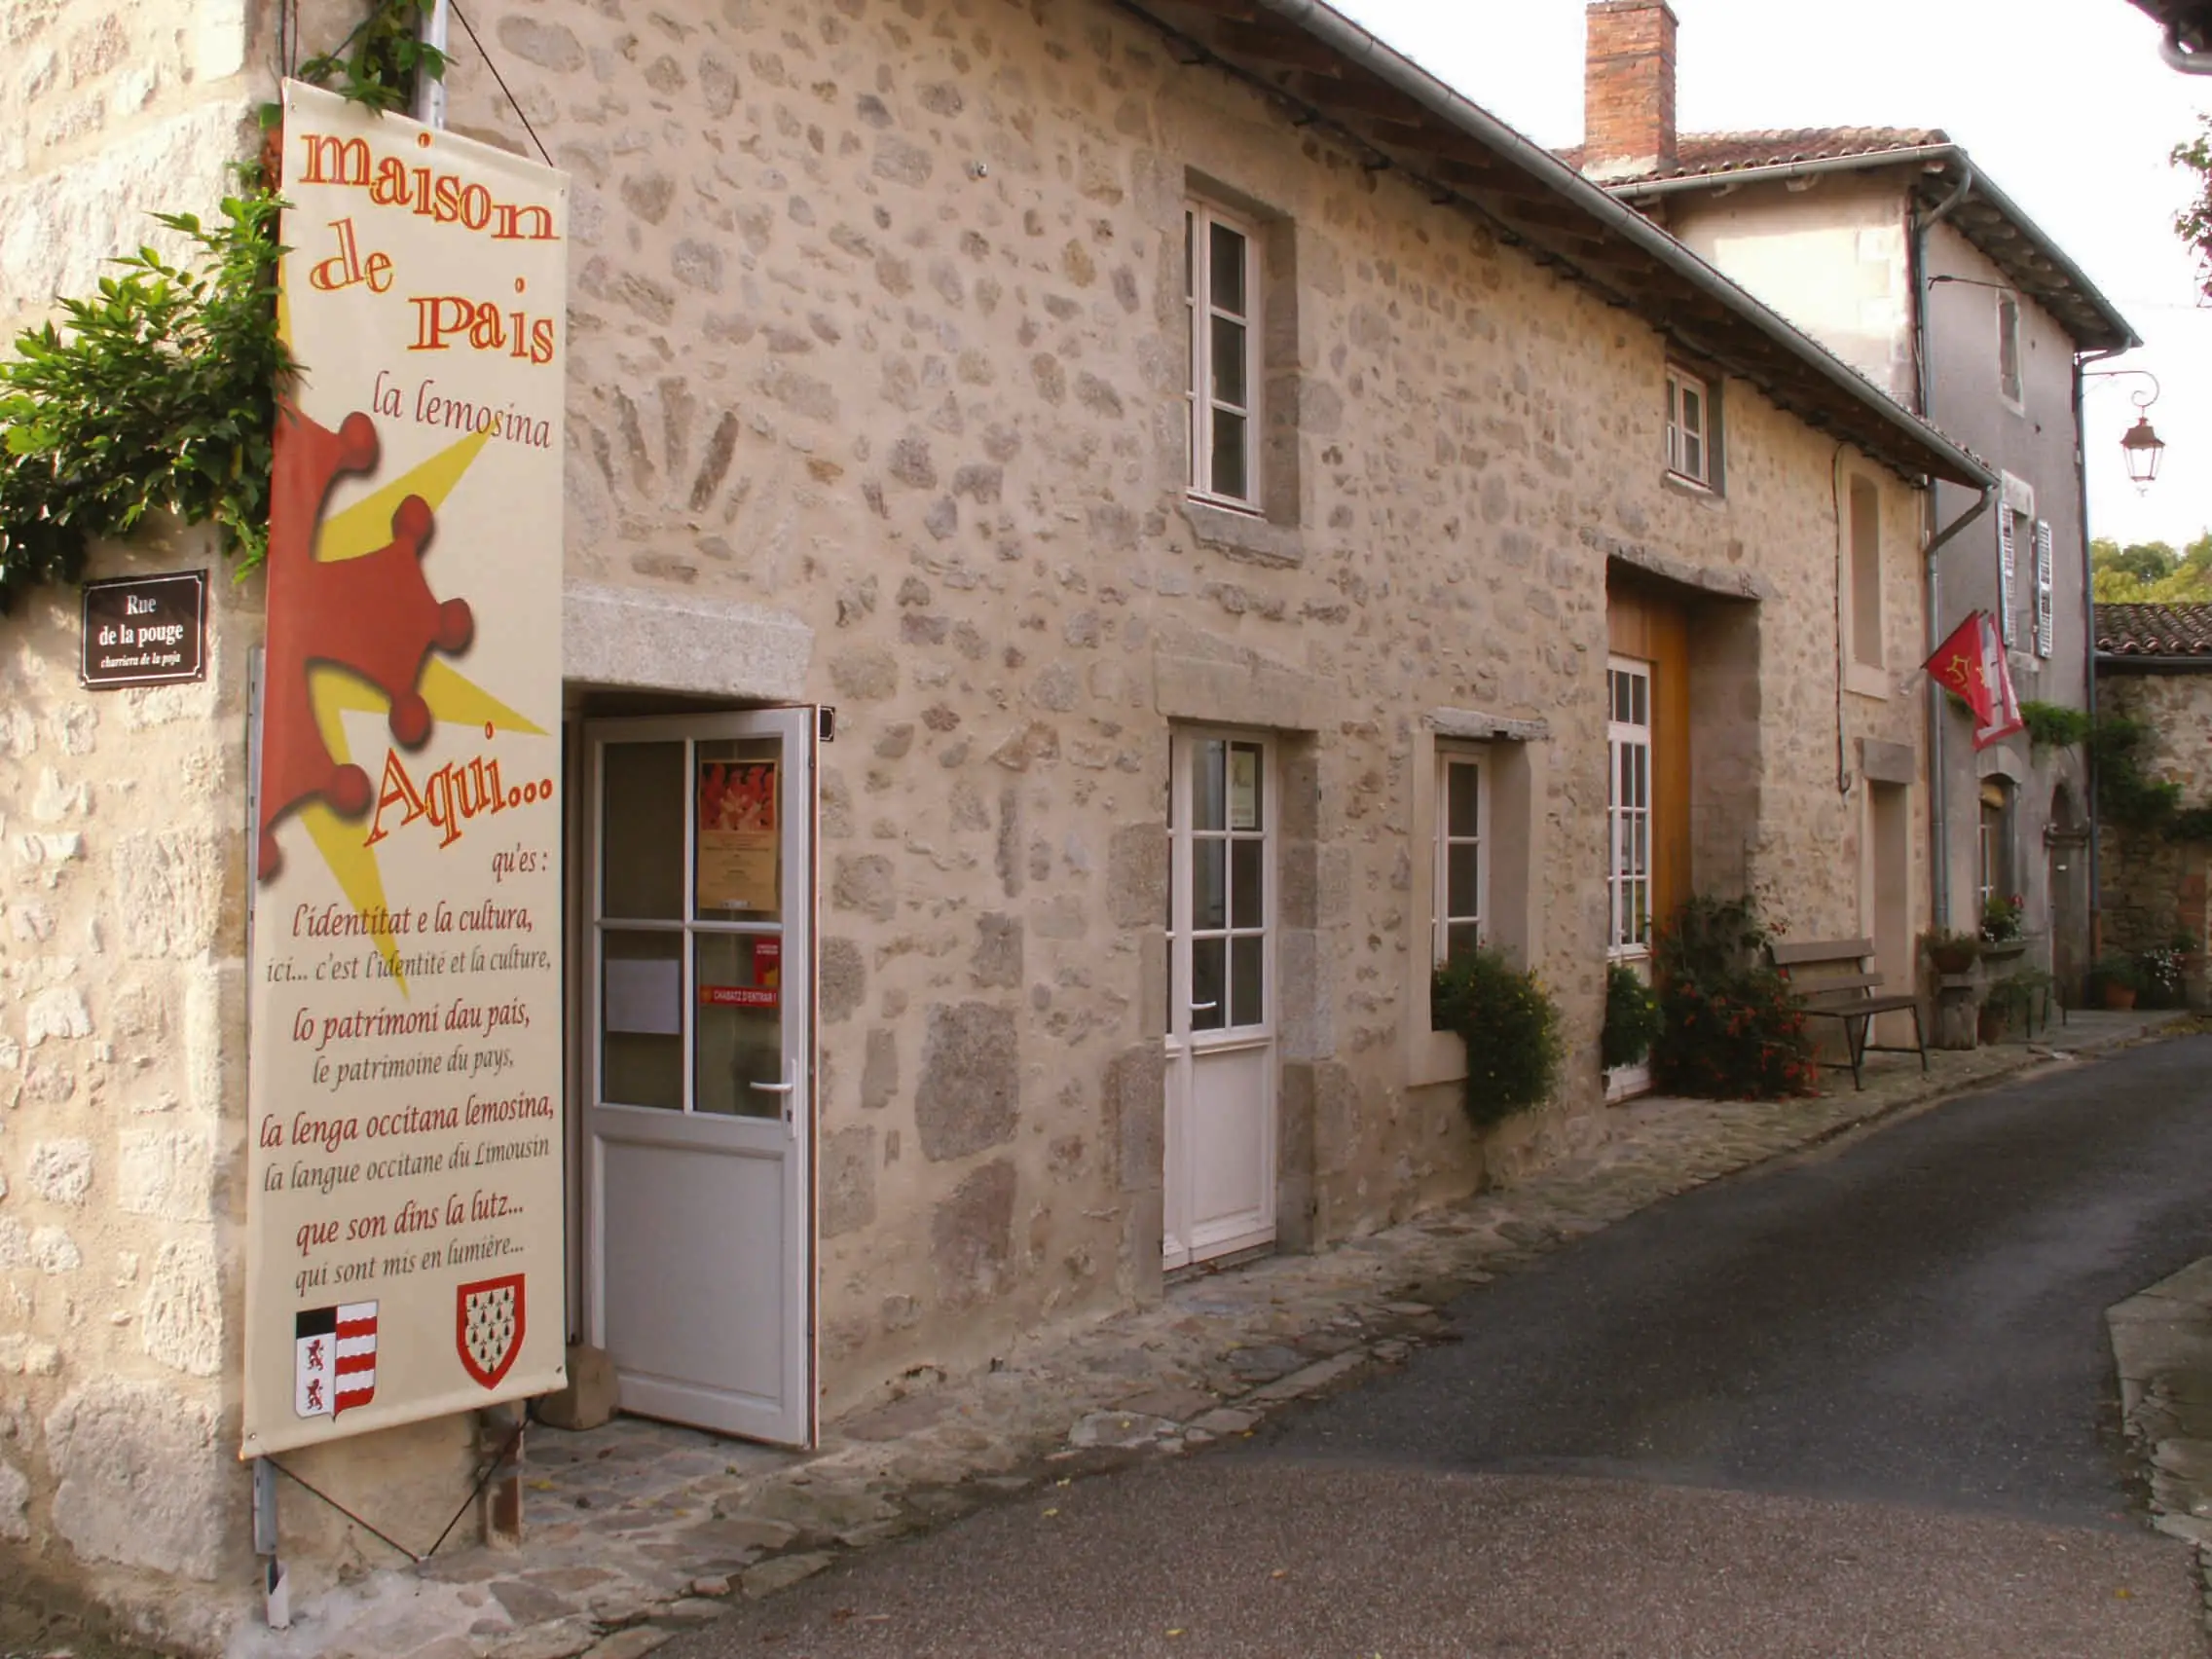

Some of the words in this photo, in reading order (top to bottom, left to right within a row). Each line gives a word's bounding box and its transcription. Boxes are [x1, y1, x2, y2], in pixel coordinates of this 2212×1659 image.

[297, 131, 561, 240] maison
[309, 216, 394, 293] de
[373, 370, 403, 418] la
[416, 379, 551, 449] lemosina
[126, 594, 157, 615] Rue
[98, 625, 117, 645] de
[120, 623, 134, 644] la
[137, 623, 183, 647] pouge
[139, 652, 150, 666] de
[152, 652, 161, 664] la
[362, 719, 554, 849] Aqui...
[292, 902, 412, 939] l'identitat
[417, 909, 428, 934] e
[434, 900, 452, 933] la
[459, 899, 533, 934] cultura,
[267, 956, 308, 983] ici...
[315, 952, 358, 981] c'est
[365, 949, 446, 978] l'identité
[451, 953, 466, 973] et
[470, 944, 486, 972] la
[490, 942, 552, 972] culture,
[292, 1007, 314, 1043] lo
[314, 1002, 439, 1051] patrimoni
[444, 998, 482, 1030] dau
[482, 997, 531, 1038] pais,
[313, 1054, 330, 1085] le
[329, 1051, 443, 1092] patrimoine
[447, 1044, 468, 1072] du
[259, 1113, 283, 1148] la
[291, 1110, 359, 1154] lenga
[365, 1104, 460, 1138] occitana
[465, 1090, 554, 1126] lemosina,
[264, 1162, 283, 1192] la
[291, 1160, 360, 1195] langue
[366, 1152, 443, 1181] occitane
[448, 1141, 470, 1169] du
[474, 1135, 550, 1165] Limousin
[296, 1218, 340, 1257] que
[346, 1211, 387, 1242] son
[393, 1198, 438, 1235] dins
[445, 1193, 464, 1226] la
[470, 1188, 524, 1223] lutz...
[295, 1267, 329, 1299] qui
[334, 1260, 377, 1285] sont
[383, 1254, 416, 1276] mis
[422, 1249, 443, 1272] en
[447, 1234, 525, 1266] lumière...
